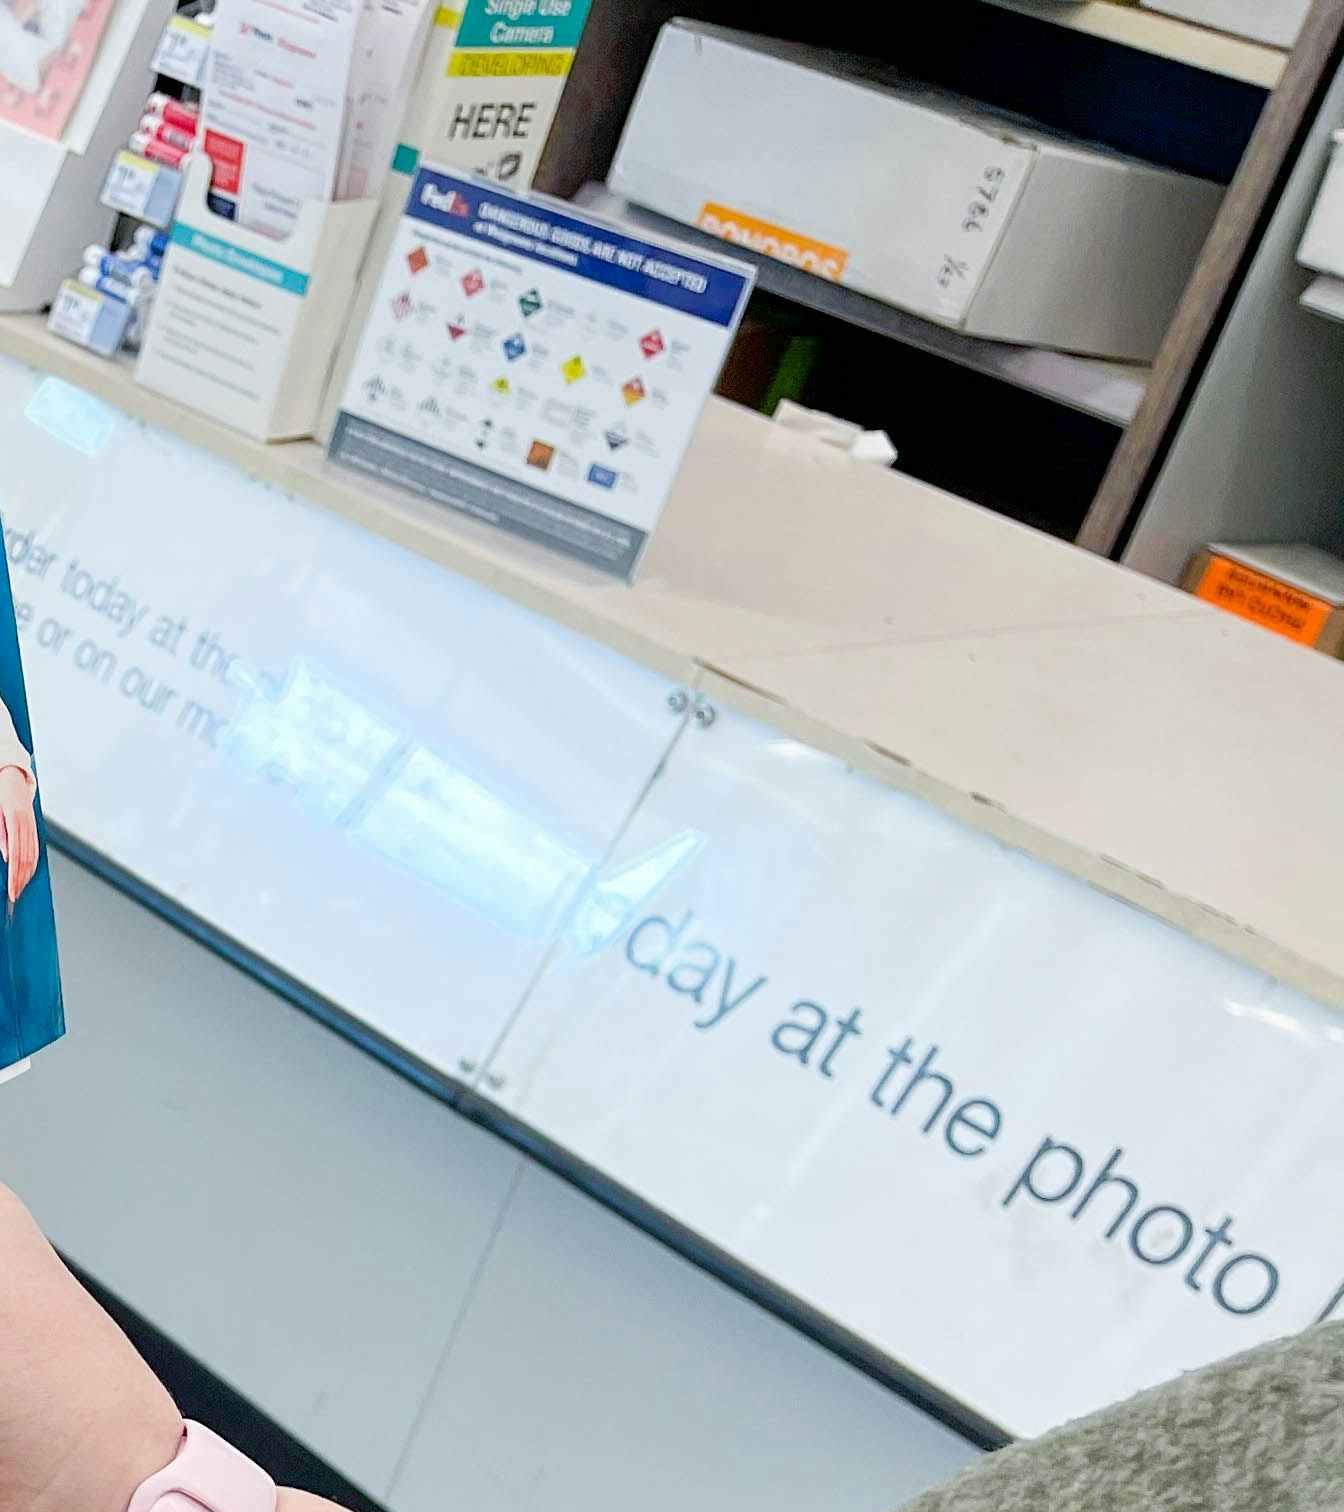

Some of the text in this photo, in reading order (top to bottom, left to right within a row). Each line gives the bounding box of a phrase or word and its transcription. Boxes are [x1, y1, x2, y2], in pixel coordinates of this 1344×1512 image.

[447, 103, 538, 141] HERE
[61, 558, 149, 638] today
[150, 611, 186, 656] at
[37, 617, 70, 651] or
[73, 639, 117, 684] on
[120, 665, 178, 713] our
[624, 912, 1281, 1316] day at the photo
